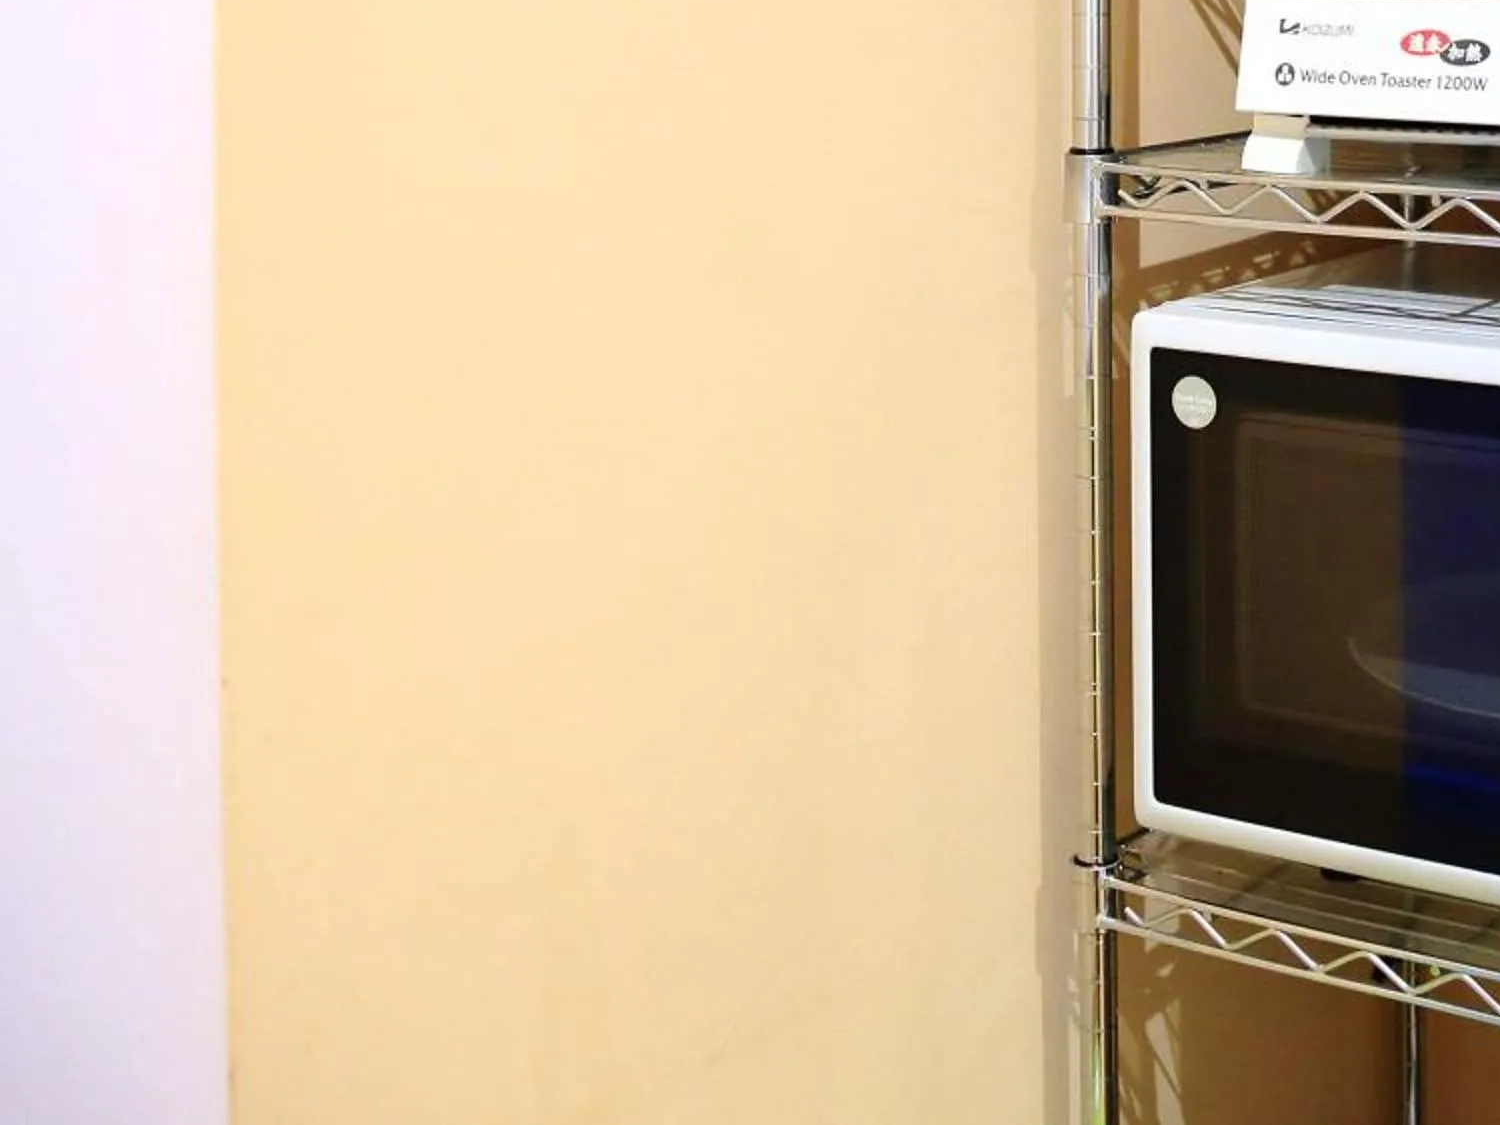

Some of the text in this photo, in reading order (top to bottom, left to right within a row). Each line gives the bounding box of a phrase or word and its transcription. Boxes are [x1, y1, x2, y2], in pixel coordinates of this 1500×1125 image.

[1300, 68, 1488, 91] Wide Oven Toaster 1200W
